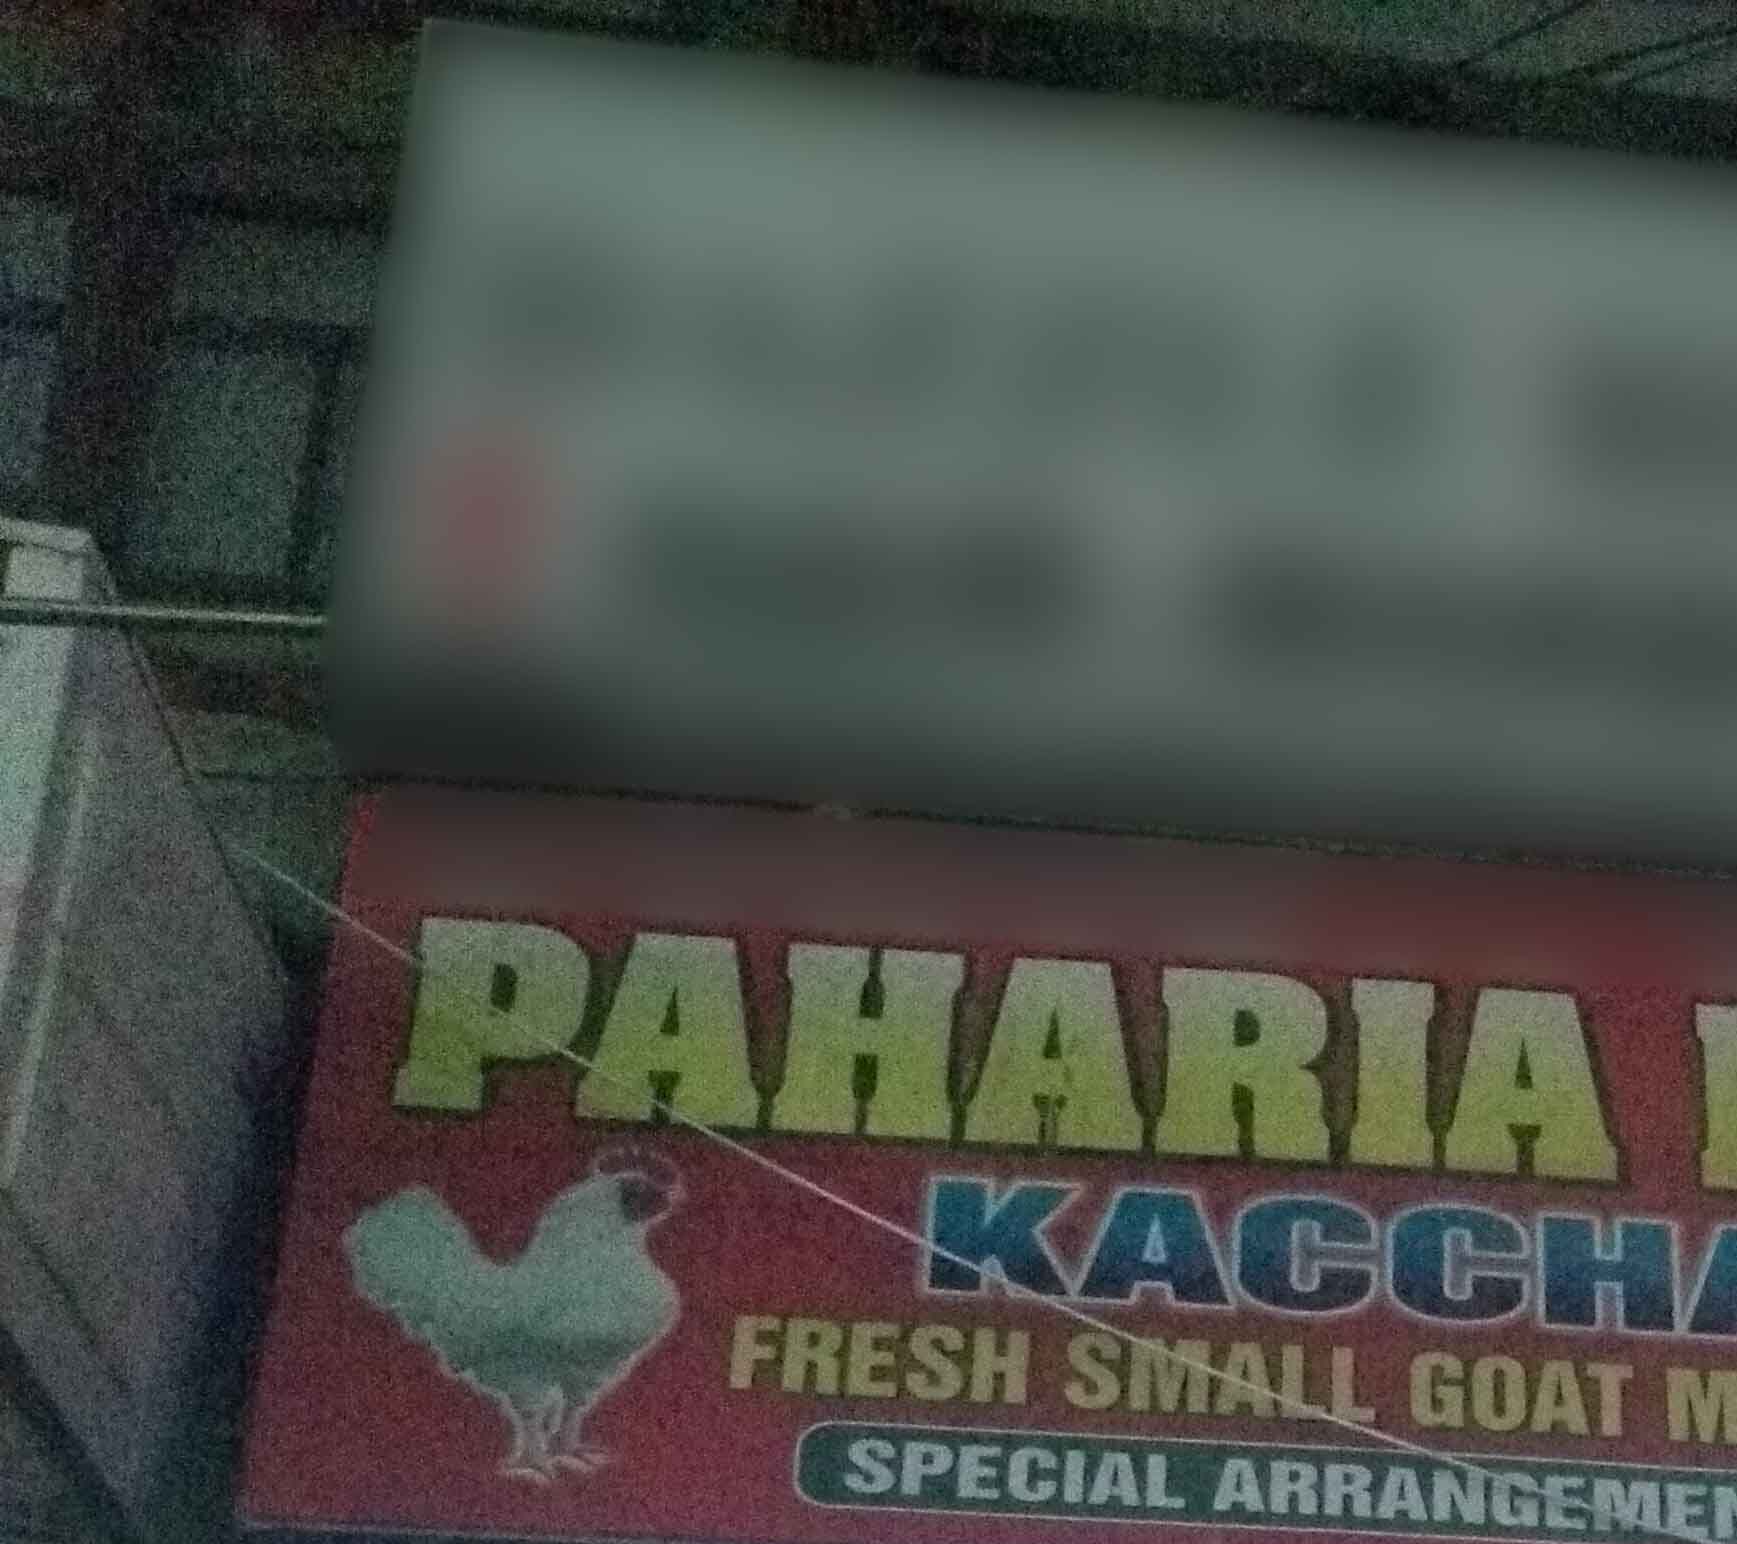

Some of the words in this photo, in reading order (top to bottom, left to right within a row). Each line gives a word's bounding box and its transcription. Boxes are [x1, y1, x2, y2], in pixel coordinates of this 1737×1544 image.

[394, 915, 1622, 1185] PAHARIA
[728, 1314, 1029, 1404] FRESH
[1060, 1340, 1376, 1424] SMALL
[1408, 1350, 1632, 1437] GOAT
[843, 1437, 1187, 1512] SPECIAL
